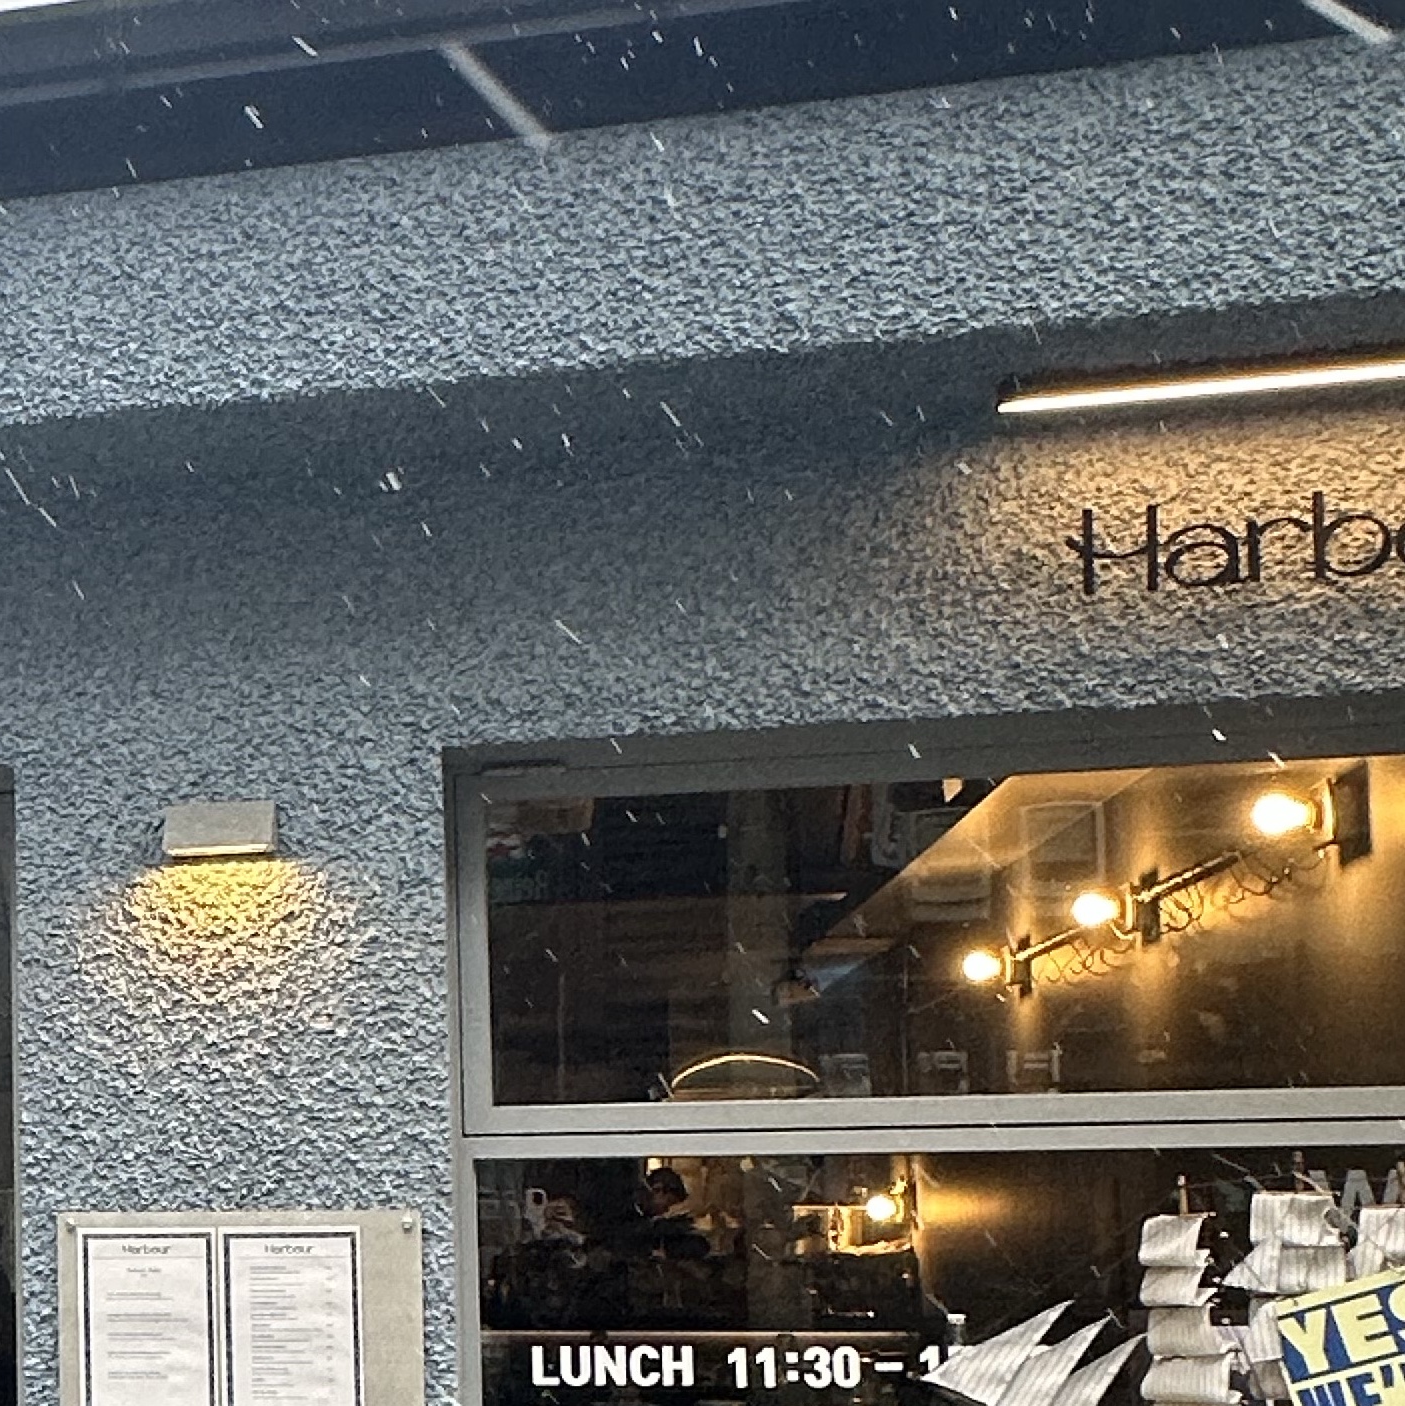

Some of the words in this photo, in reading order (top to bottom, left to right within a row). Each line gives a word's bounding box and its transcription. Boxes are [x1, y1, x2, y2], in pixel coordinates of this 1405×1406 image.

[1065, 491, 1405, 595] Harb
[531, 1344, 694, 1387] LUNCH
[727, 1345, 862, 1389] 11:30
